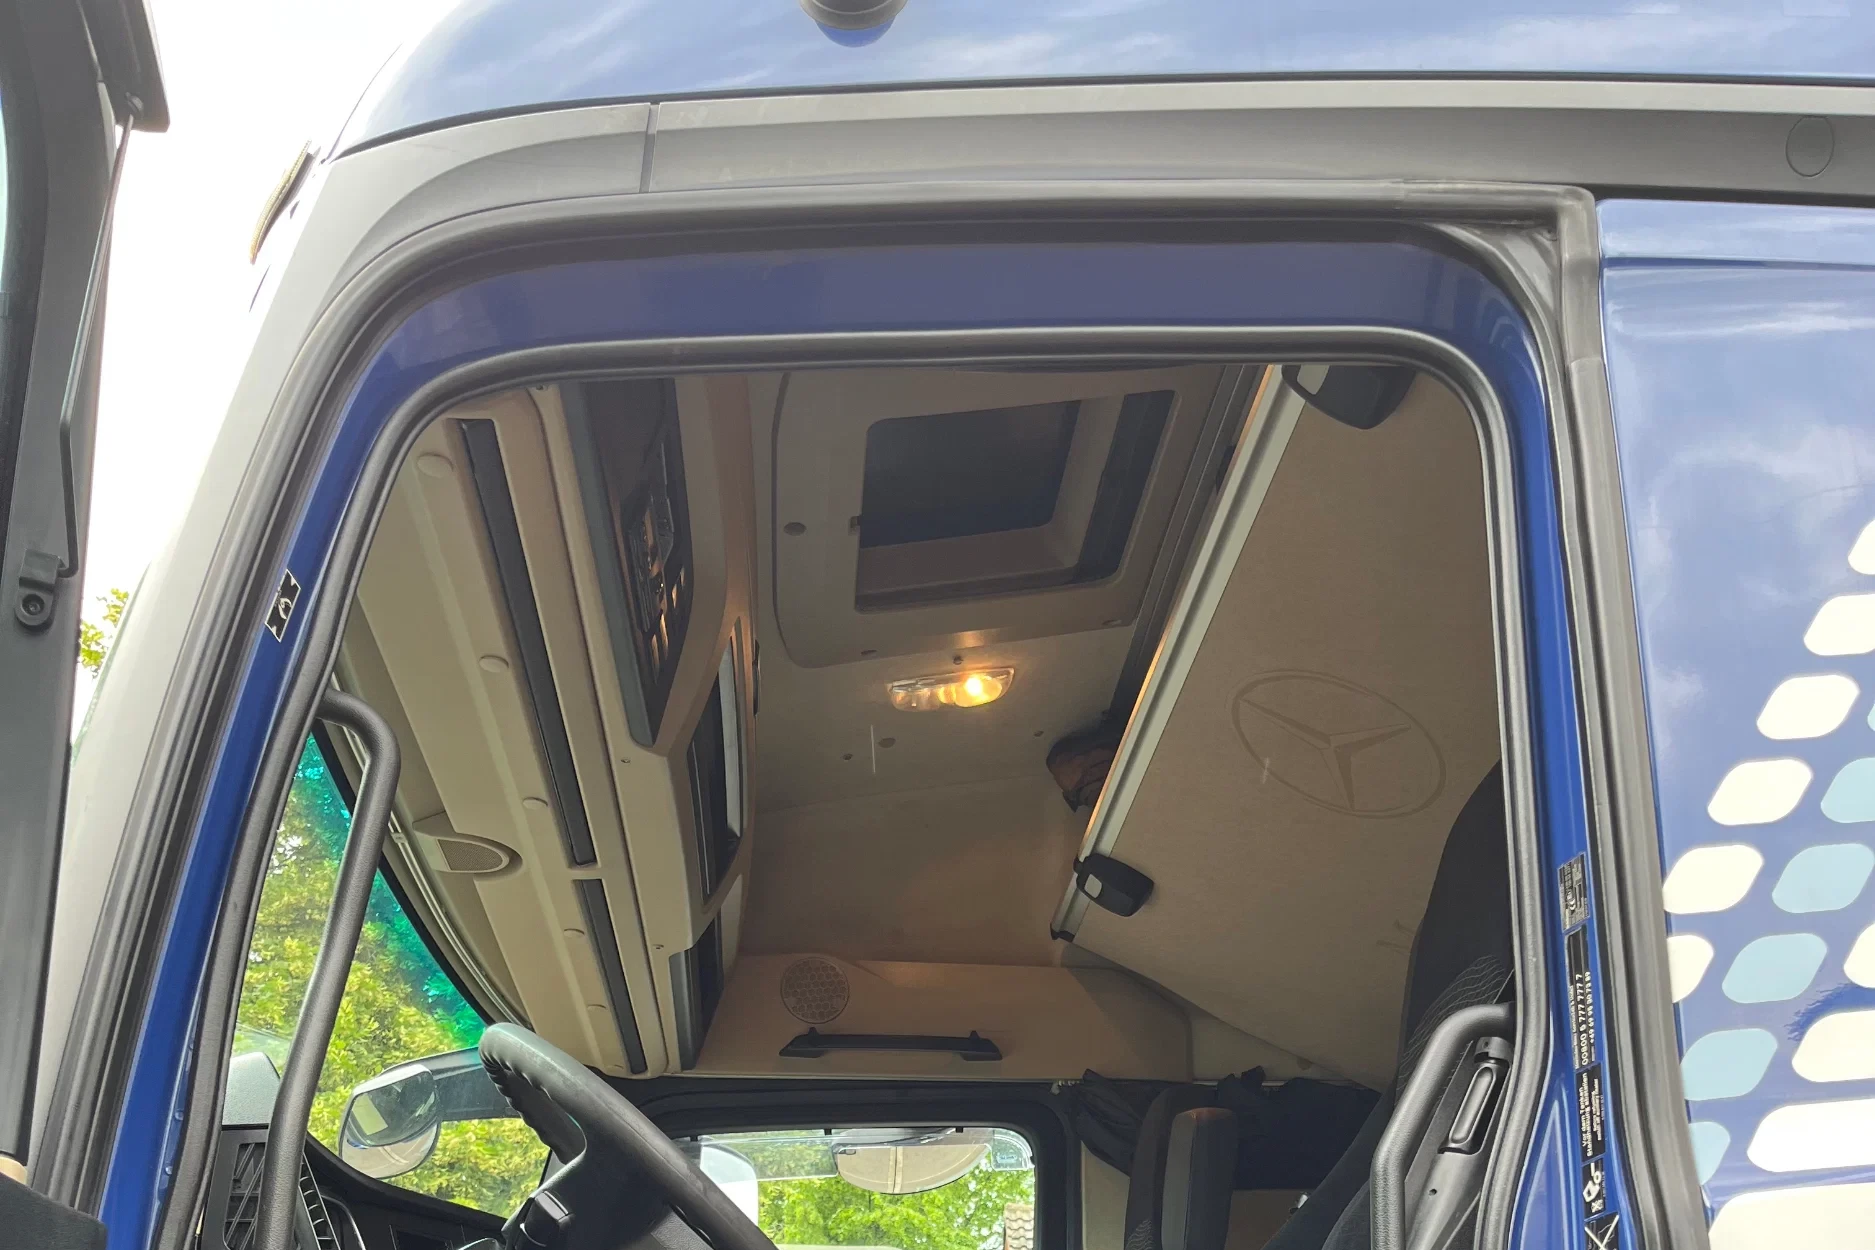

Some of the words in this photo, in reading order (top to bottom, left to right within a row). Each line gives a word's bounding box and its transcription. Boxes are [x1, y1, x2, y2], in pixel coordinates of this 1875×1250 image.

[1576, 983, 1584, 1002] 777
[1578, 1004, 1586, 1023] 777
[1580, 1033, 1588, 1066] 00800
